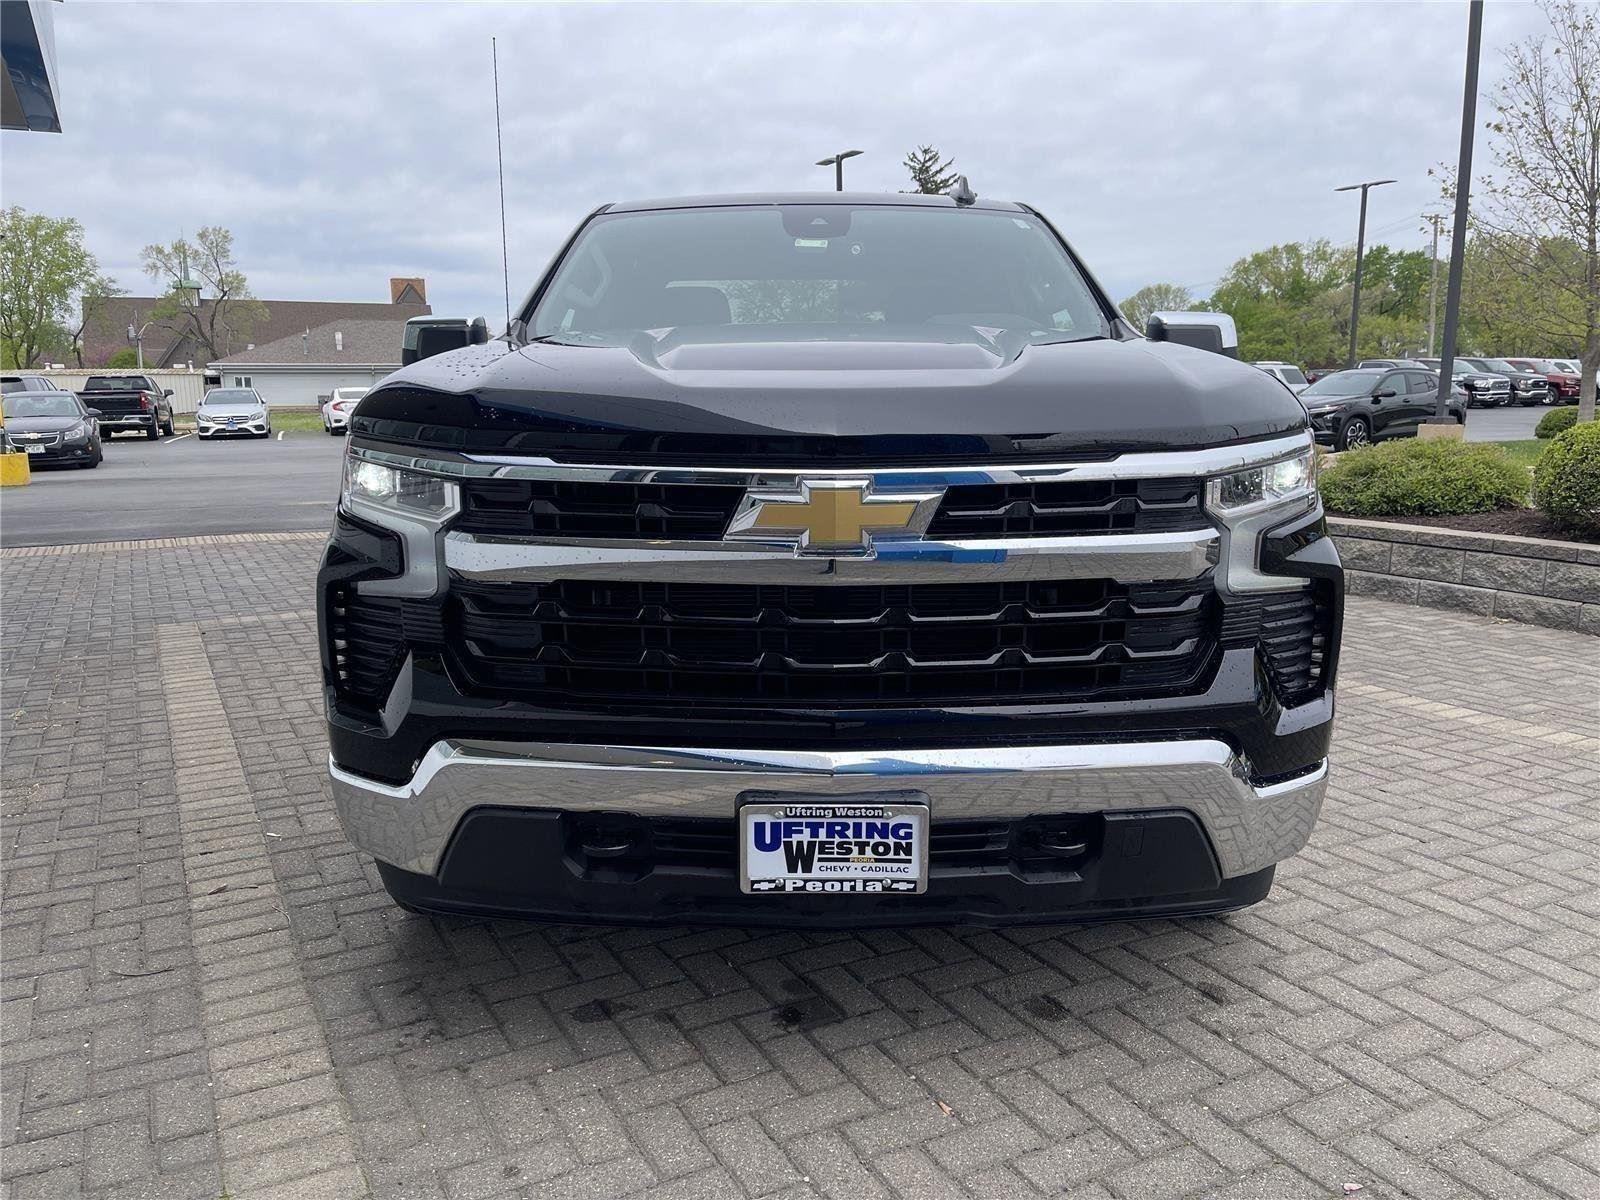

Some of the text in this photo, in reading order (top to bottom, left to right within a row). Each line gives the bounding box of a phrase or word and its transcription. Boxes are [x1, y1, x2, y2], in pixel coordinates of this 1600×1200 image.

[786, 807, 883, 818] Uftring Weston
[753, 821, 913, 852] UFTRING
[783, 840, 912, 873] WESTON
[860, 865, 909, 873] CADILLAC
[785, 880, 883, 892] Peoria
